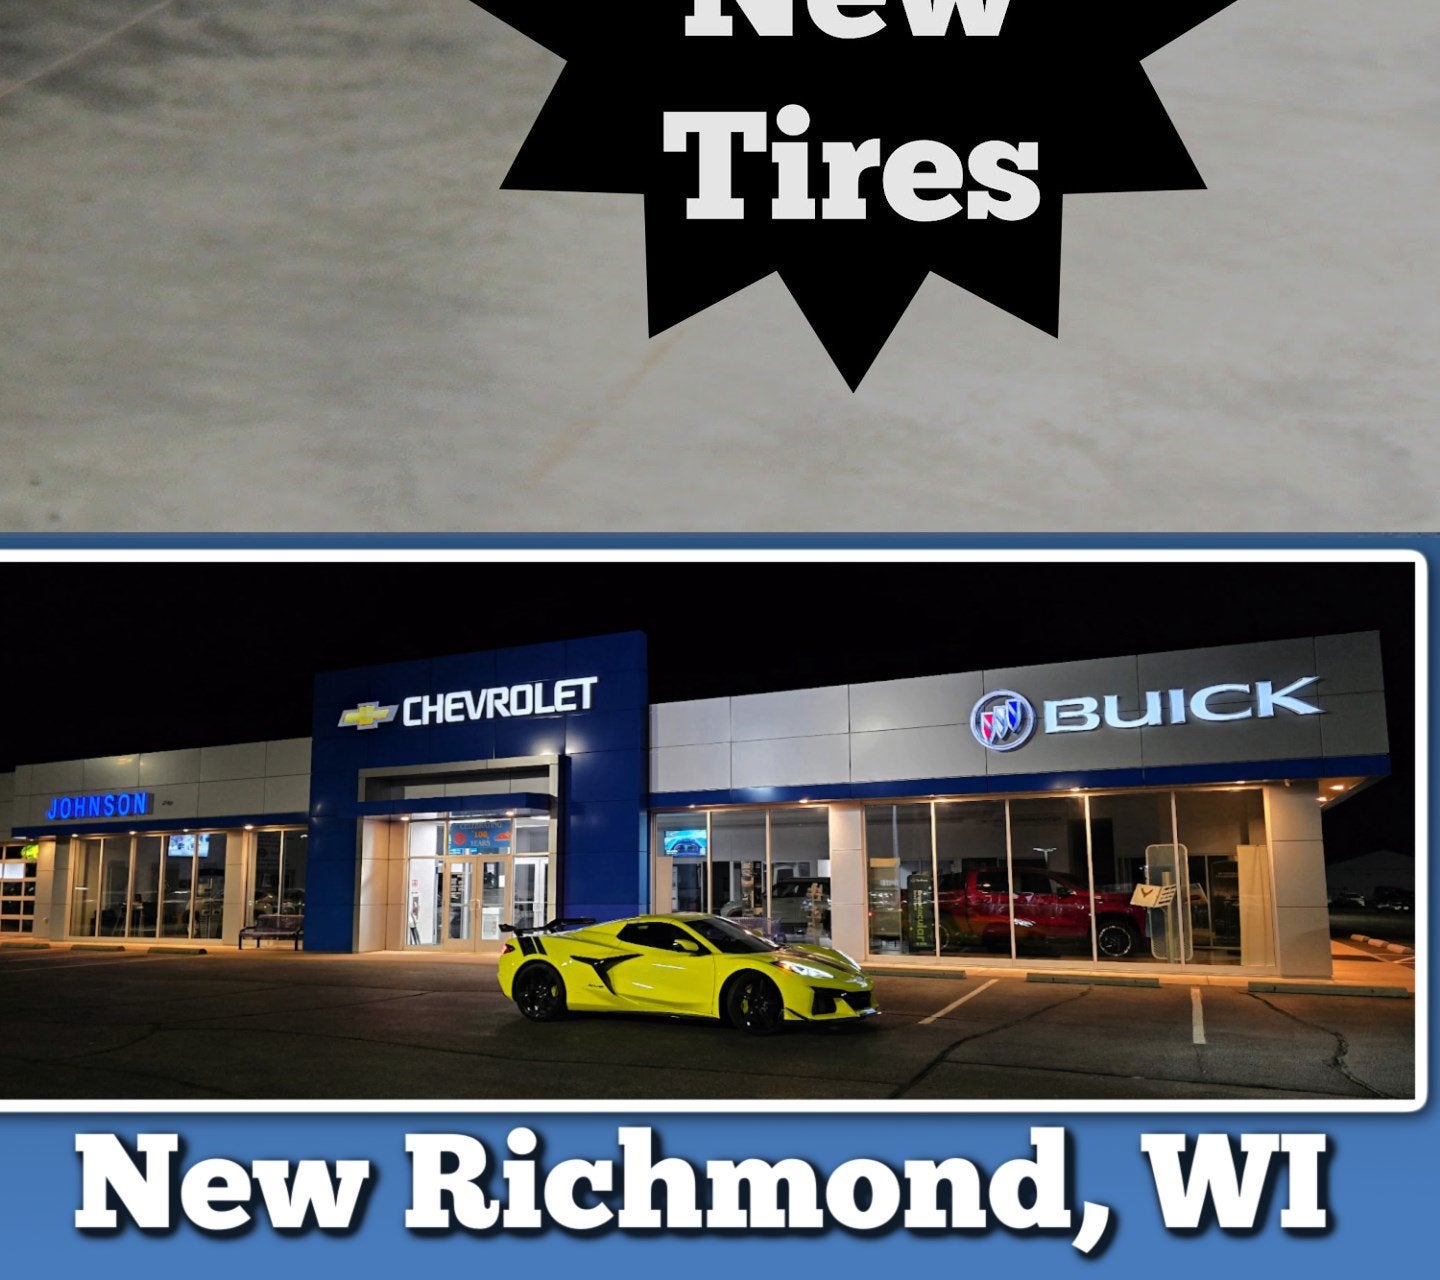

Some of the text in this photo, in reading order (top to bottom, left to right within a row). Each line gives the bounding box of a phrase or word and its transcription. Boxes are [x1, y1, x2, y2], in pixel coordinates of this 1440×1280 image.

[403, 676, 599, 727] CHEVROLET
[1044, 676, 1326, 734] BUICK
[46, 791, 150, 820] JOHNSON
